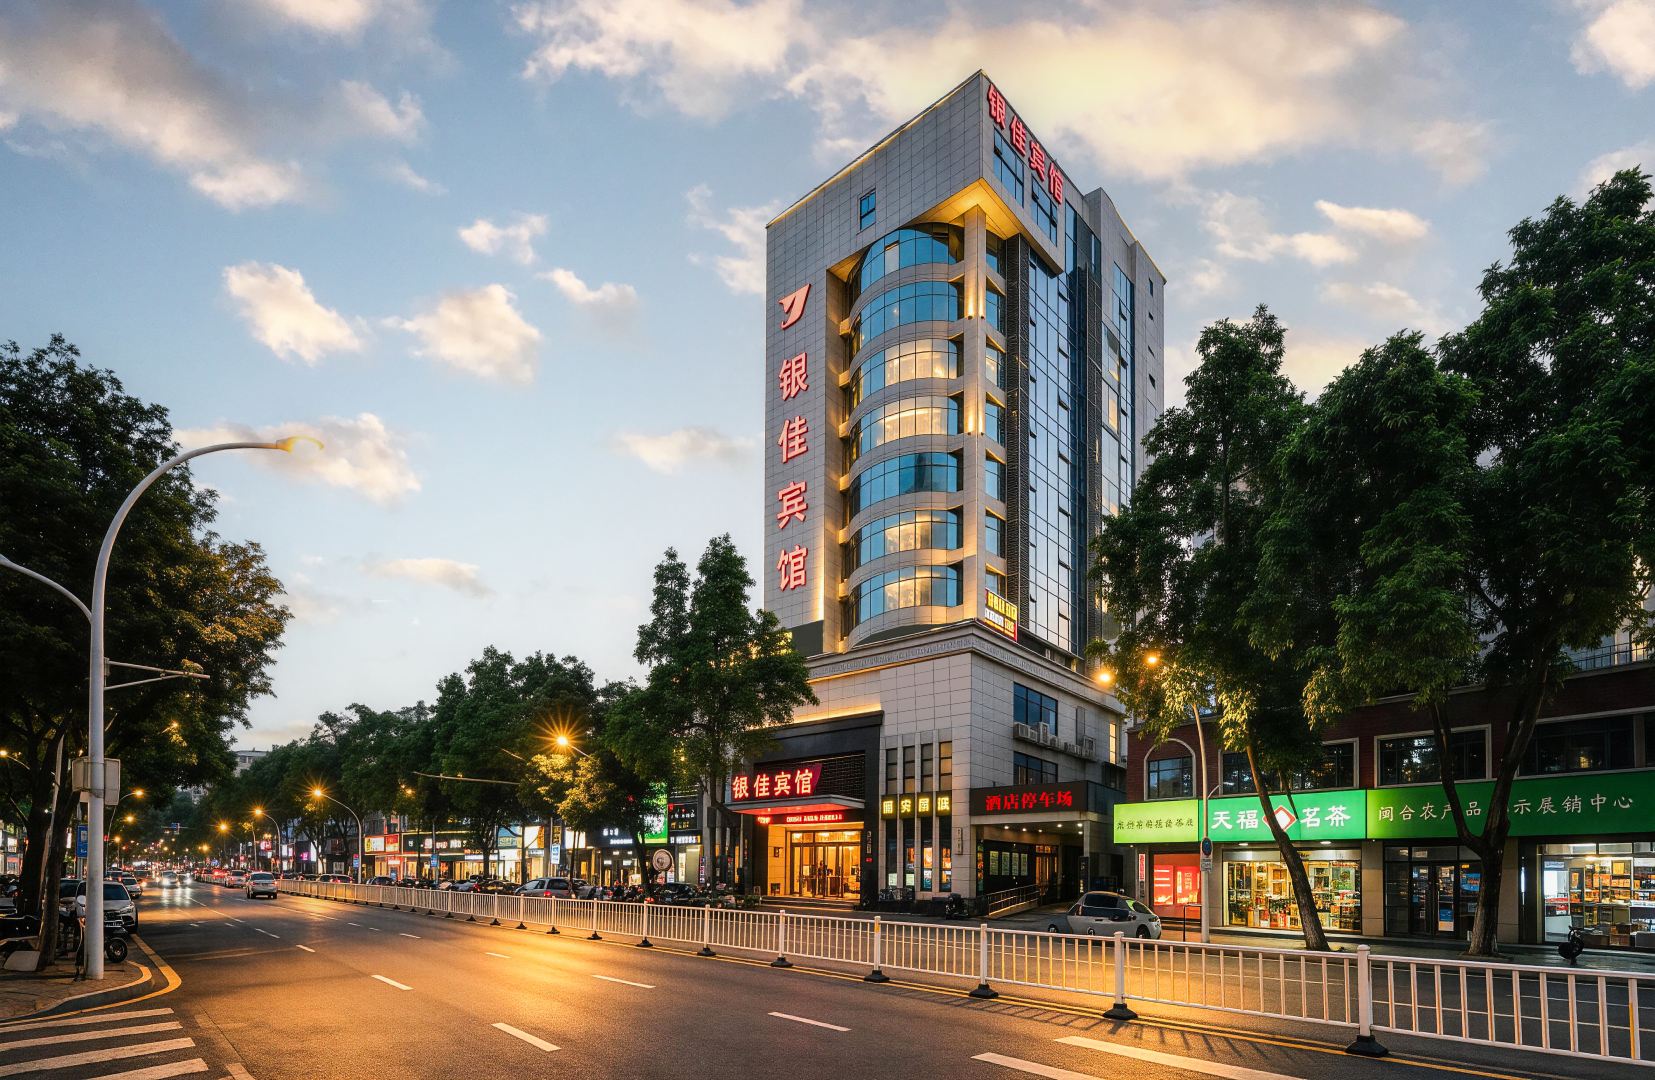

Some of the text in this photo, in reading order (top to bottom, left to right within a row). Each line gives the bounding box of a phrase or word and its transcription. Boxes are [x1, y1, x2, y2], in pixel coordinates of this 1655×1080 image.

[986, 83, 1064, 205] 银佳宾馆
[776, 351, 809, 592] 银佳宾馆
[732, 768, 813, 799] 银佳宾馆
[985, 790, 1073, 811] 酒店停车场
[1378, 793, 1633, 821] 闽合农产品示展销中心
